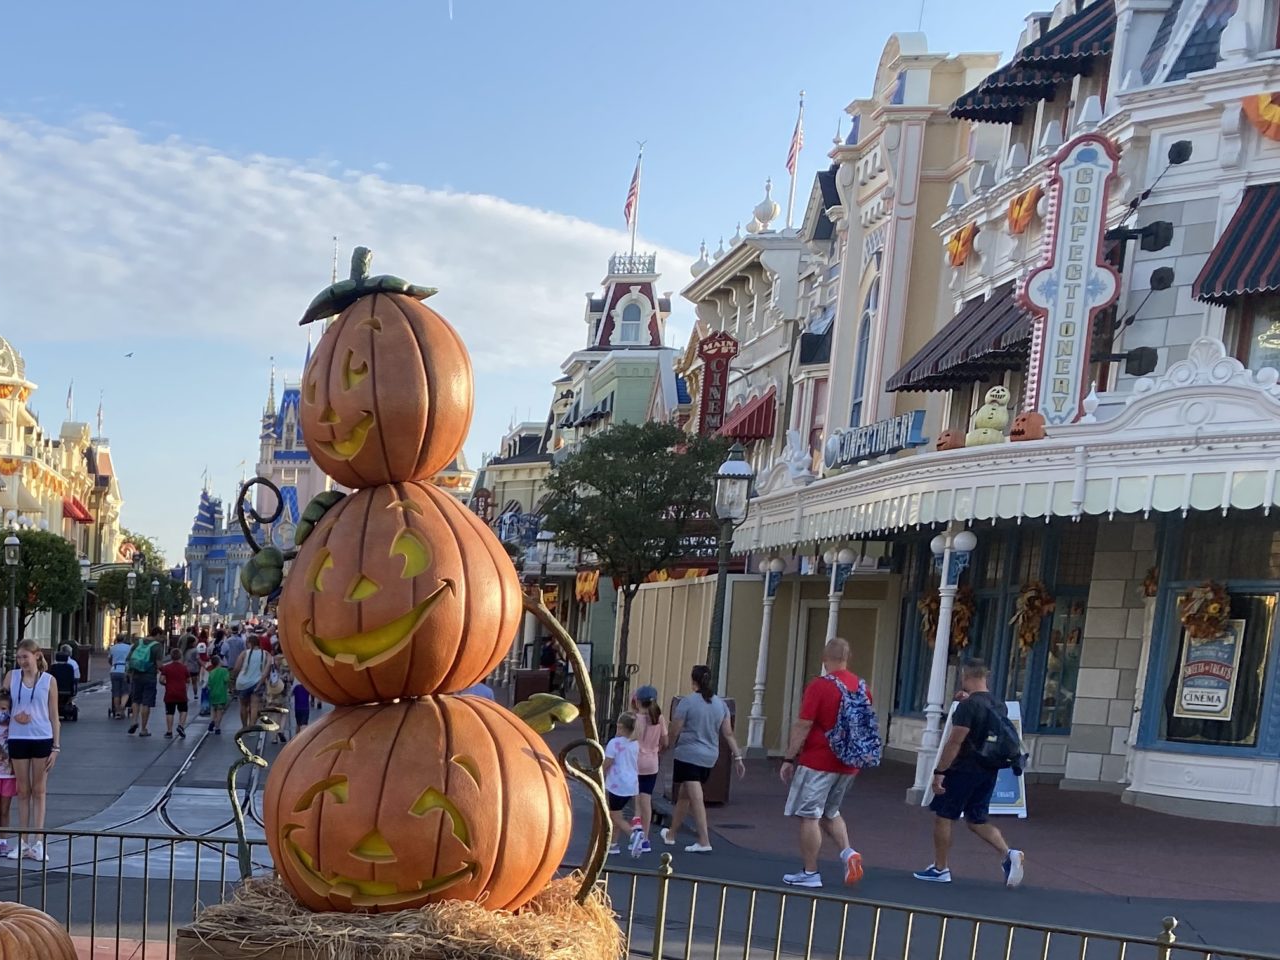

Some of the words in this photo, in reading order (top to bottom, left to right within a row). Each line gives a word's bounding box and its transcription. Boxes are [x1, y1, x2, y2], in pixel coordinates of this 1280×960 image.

[1052, 166, 1095, 413] CONFECTIONERY
[702, 340, 734, 353] MAIN
[704, 358, 727, 430] CINEM
[836, 410, 916, 464] CONFECTIONERY
[1183, 693, 1222, 704] CINEMA
